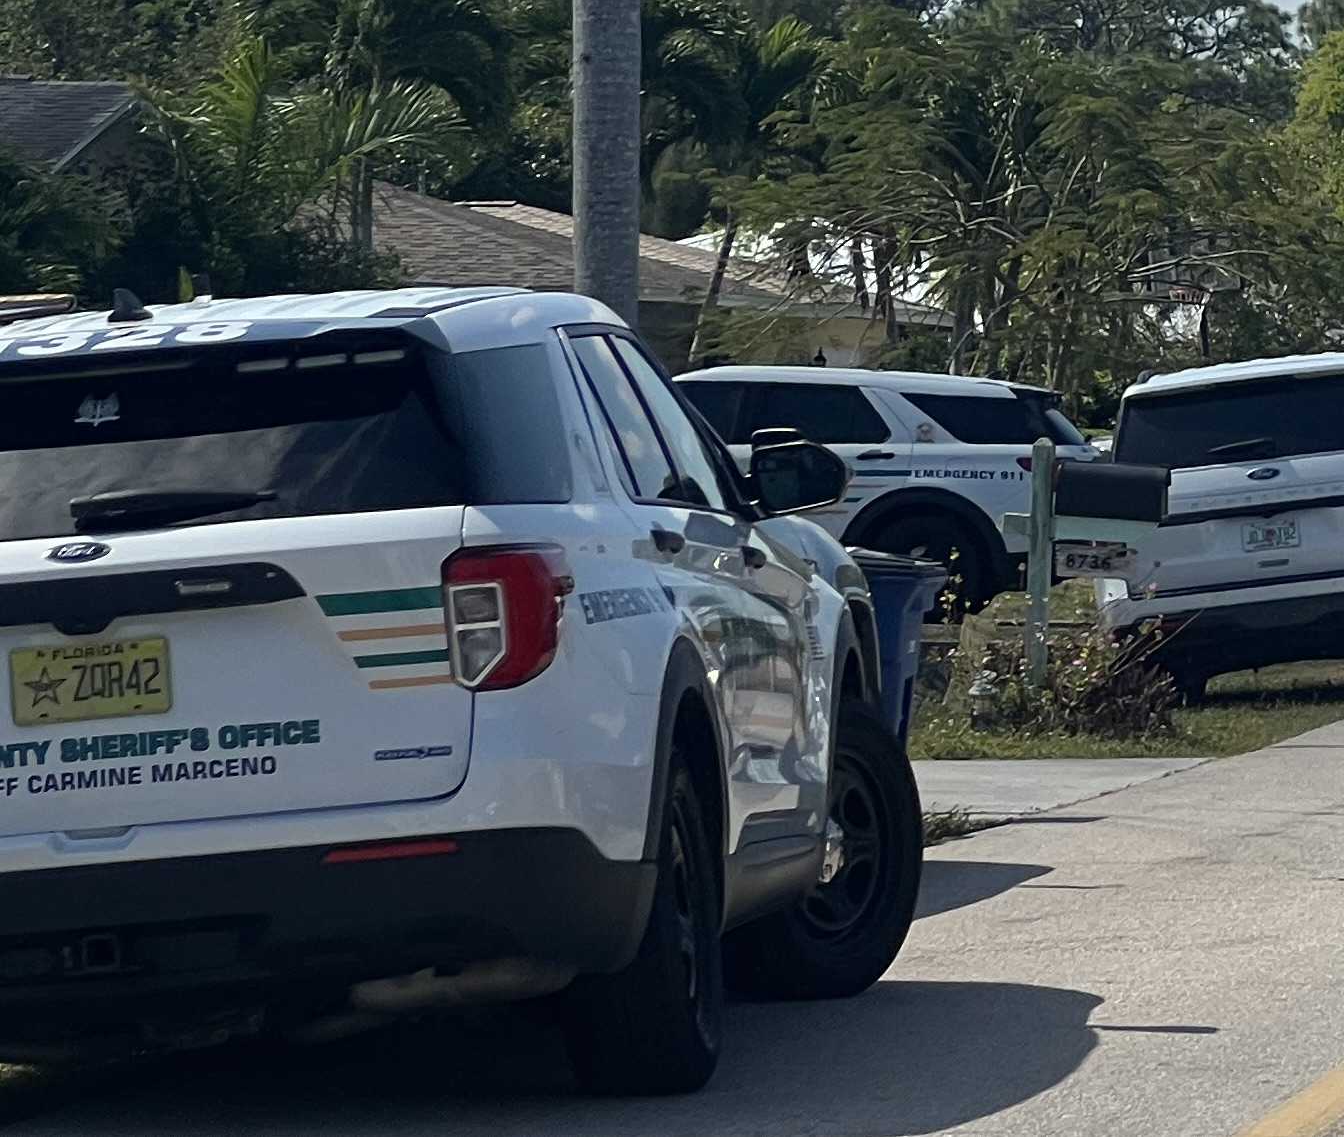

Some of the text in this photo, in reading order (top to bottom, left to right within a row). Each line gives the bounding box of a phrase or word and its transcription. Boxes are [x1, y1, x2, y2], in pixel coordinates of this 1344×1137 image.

[914, 469, 995, 480] EMERGENCY
[52, 643, 124, 661] FLORIDA
[60, 728, 210, 763] SHERIFF'S
[218, 719, 321, 750] OFFICE
[28, 766, 142, 794] CARMINE
[151, 755, 278, 784] MARCENO
